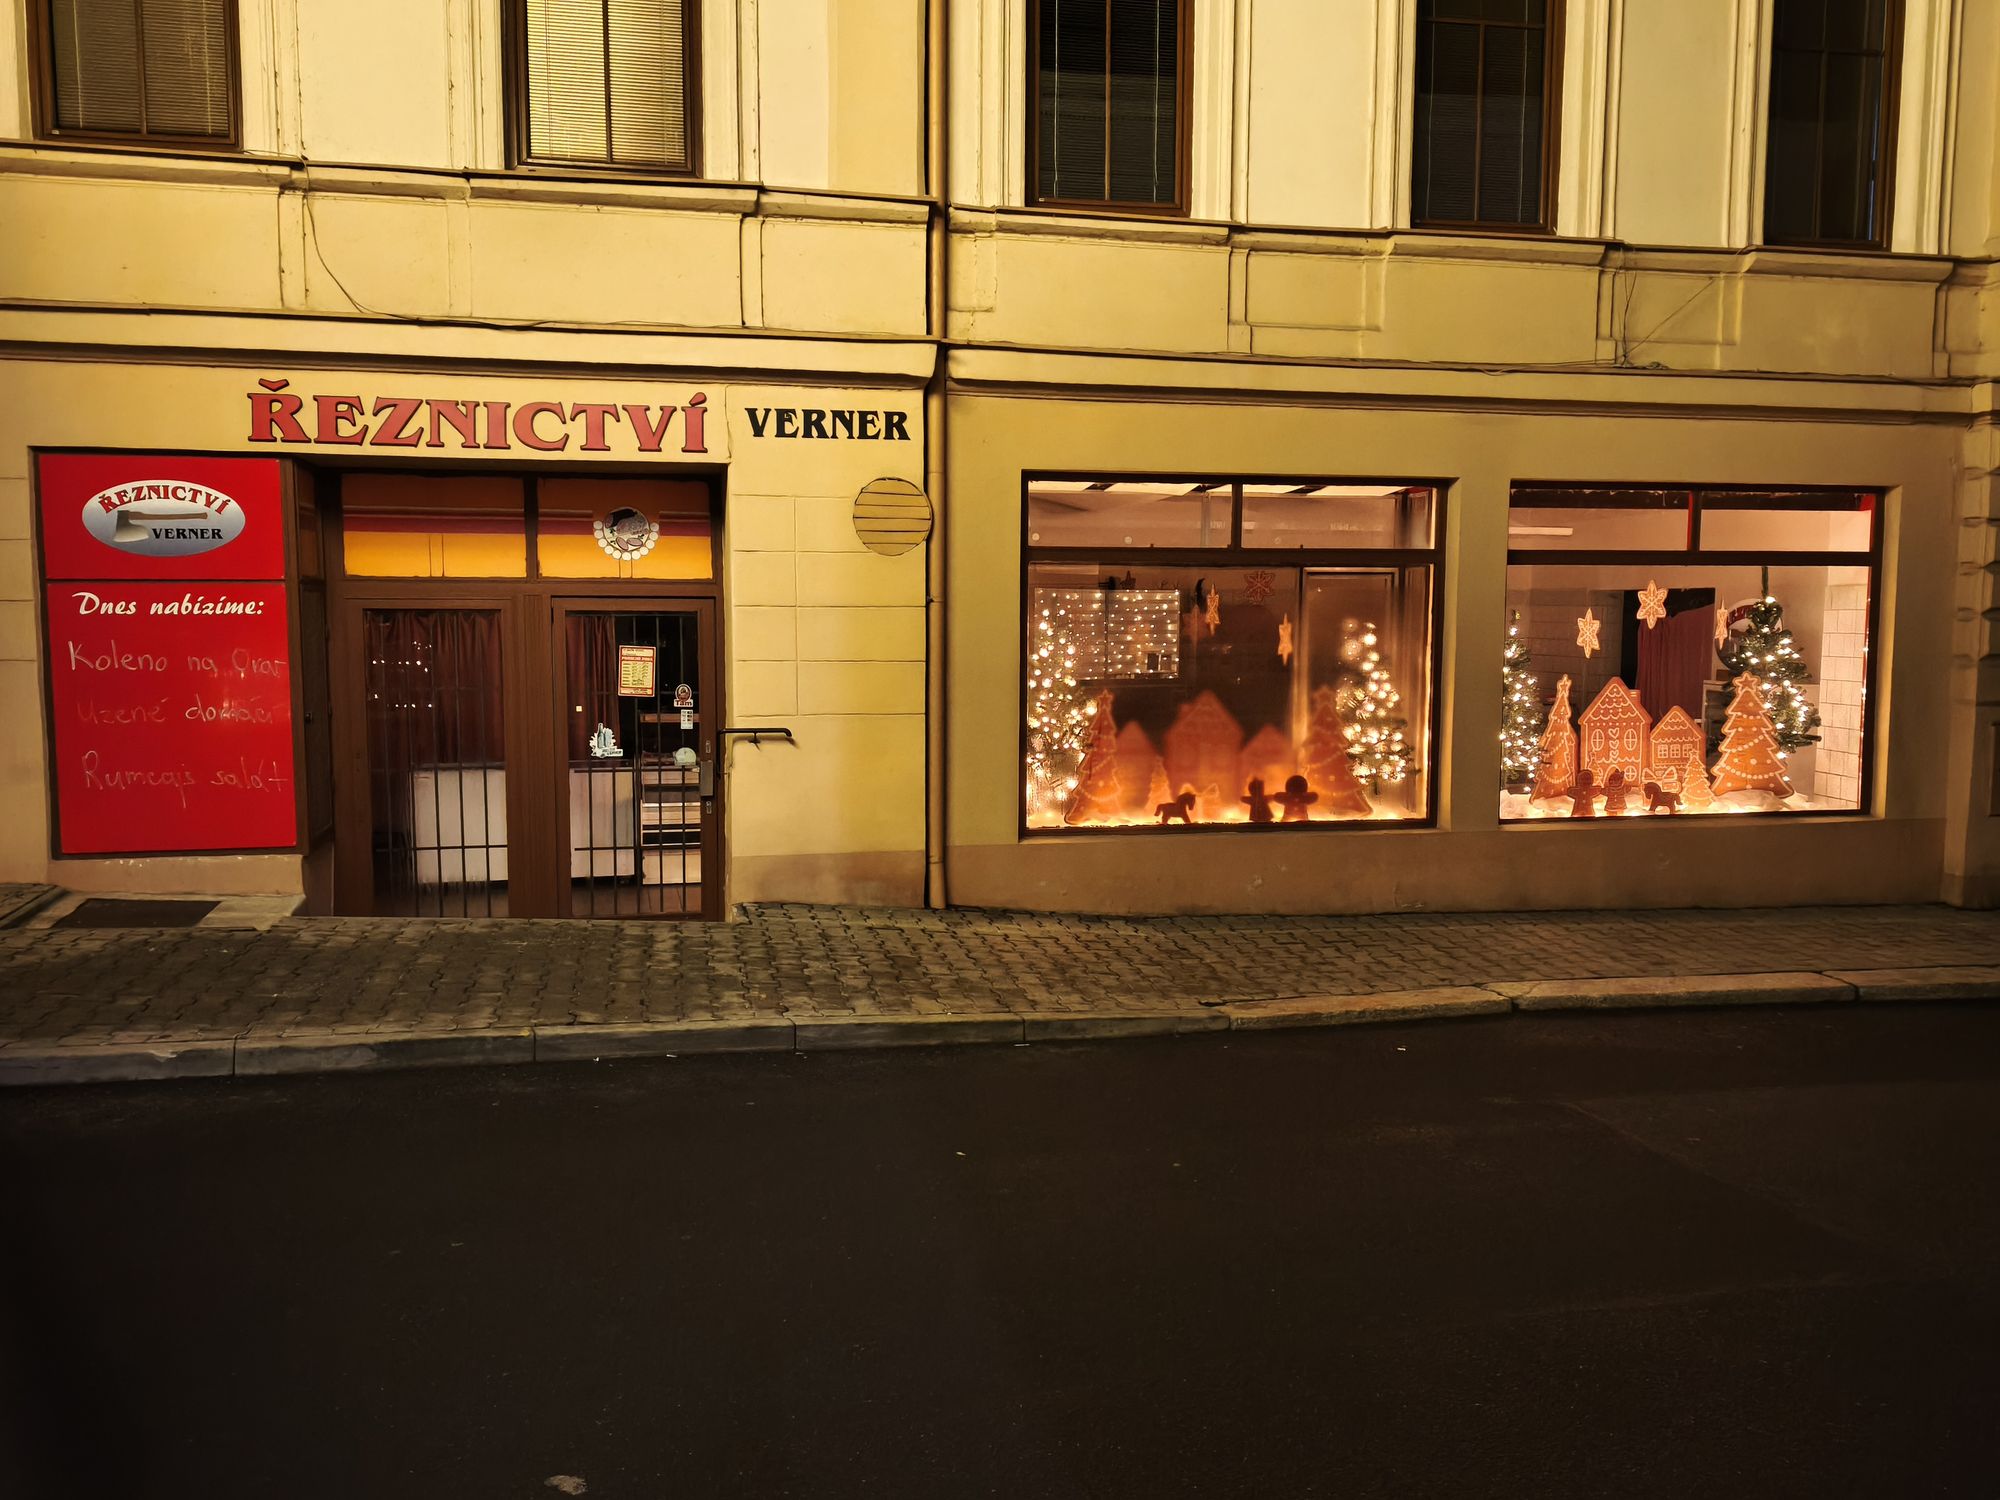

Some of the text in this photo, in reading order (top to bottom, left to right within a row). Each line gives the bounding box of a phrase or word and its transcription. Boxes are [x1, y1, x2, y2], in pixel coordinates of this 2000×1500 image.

[247, 378, 709, 453] ŘEZNICTVÍ
[745, 407, 910, 441] VERNER
[98, 485, 231, 515] ŘEZNICTVÍ
[152, 527, 223, 540] VERNER
[72, 591, 265, 615] Dnes nabízíme:
[67, 639, 169, 672] Koleno
[187, 655, 218, 674] na
[210, 755, 289, 793] salát
